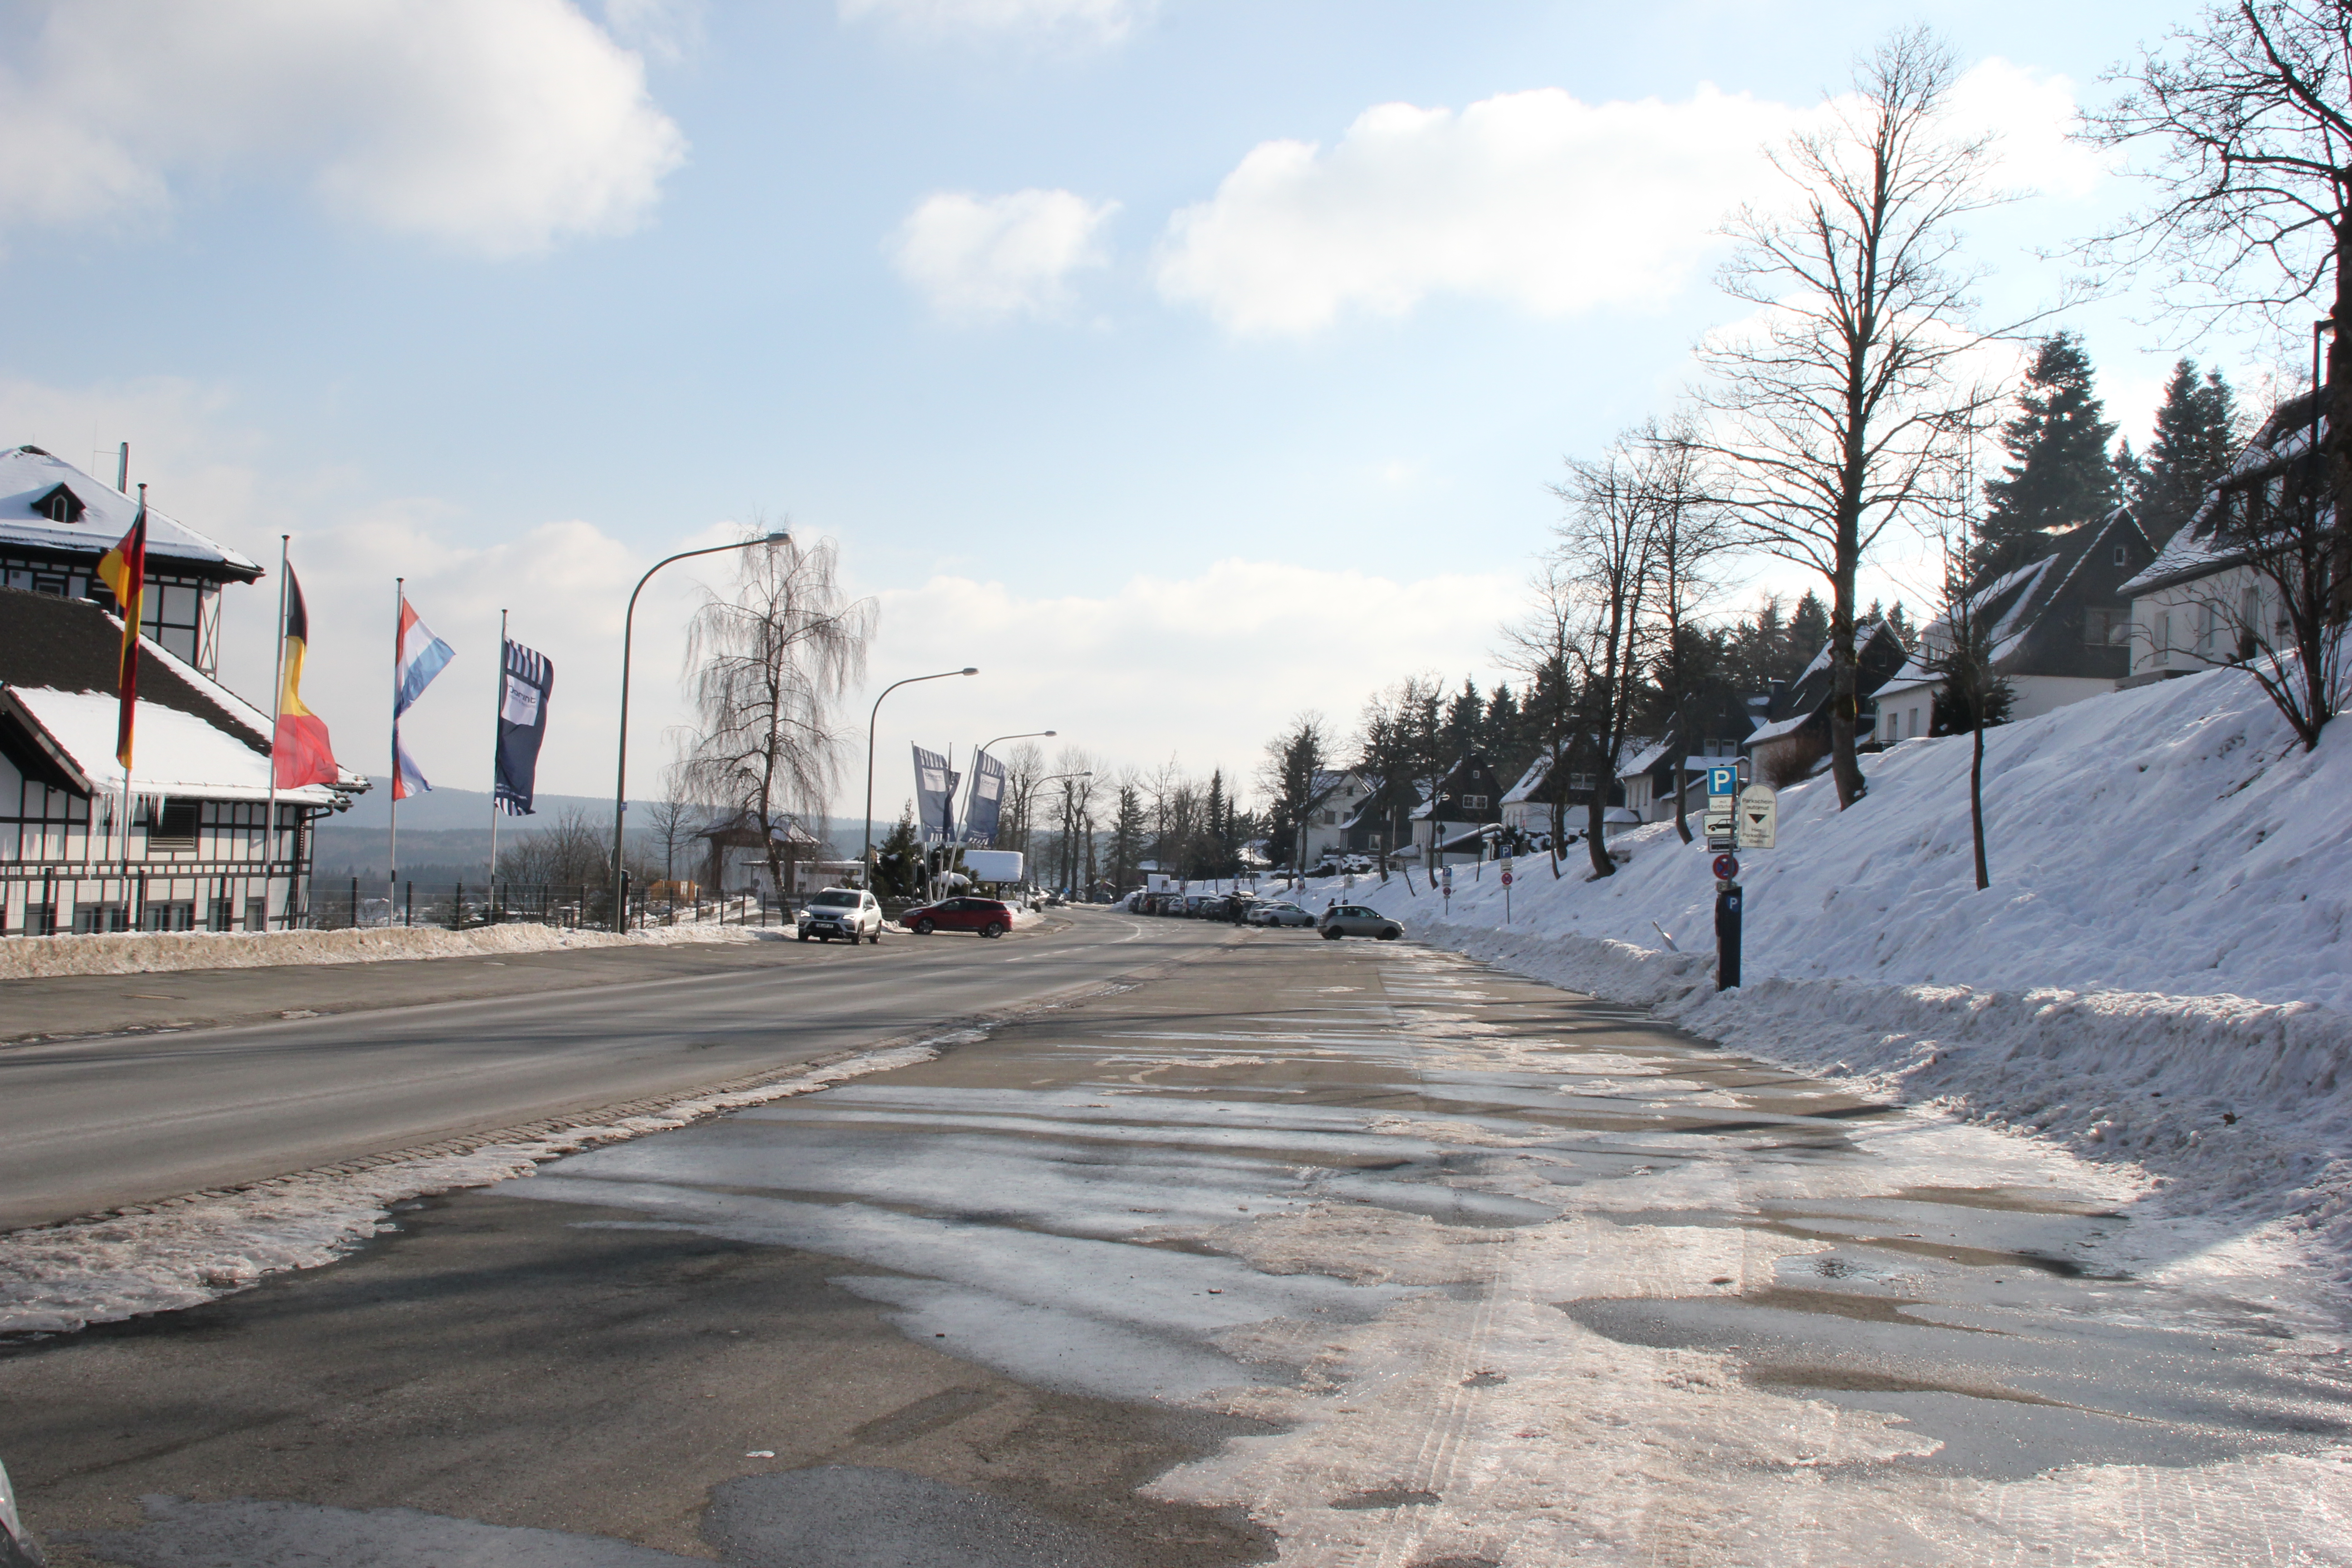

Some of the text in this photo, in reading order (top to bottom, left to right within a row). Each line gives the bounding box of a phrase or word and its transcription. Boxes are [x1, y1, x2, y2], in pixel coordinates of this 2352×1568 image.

[509, 685, 536, 704] Dorint
[1714, 770, 1730, 792] P
[1503, 847, 1509, 856] P
[1729, 897, 1738, 909] P
